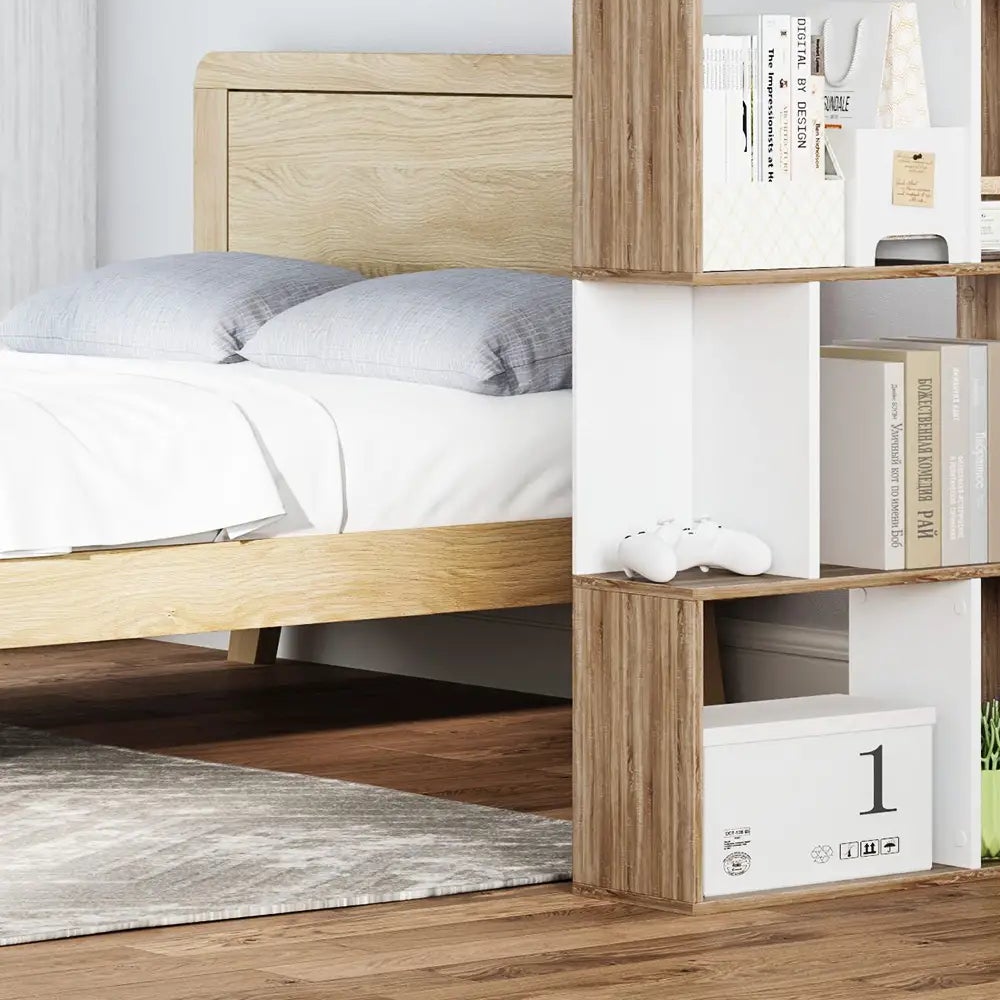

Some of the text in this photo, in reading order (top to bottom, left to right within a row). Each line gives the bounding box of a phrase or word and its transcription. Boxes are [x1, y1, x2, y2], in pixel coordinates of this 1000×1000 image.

[766, 72, 775, 152] Impressionists
[797, 18, 807, 149] DIGITAL BY DESIGN
[768, 156, 774, 171] at
[891, 423, 903, 465] Уличный
[917, 378, 938, 539] БОЖЕСТВЕННАЯ КОМЕДИЯ РАЙ
[892, 485, 899, 498] по
[891, 529, 903, 548] Боб
[859, 744, 898, 816] 1
